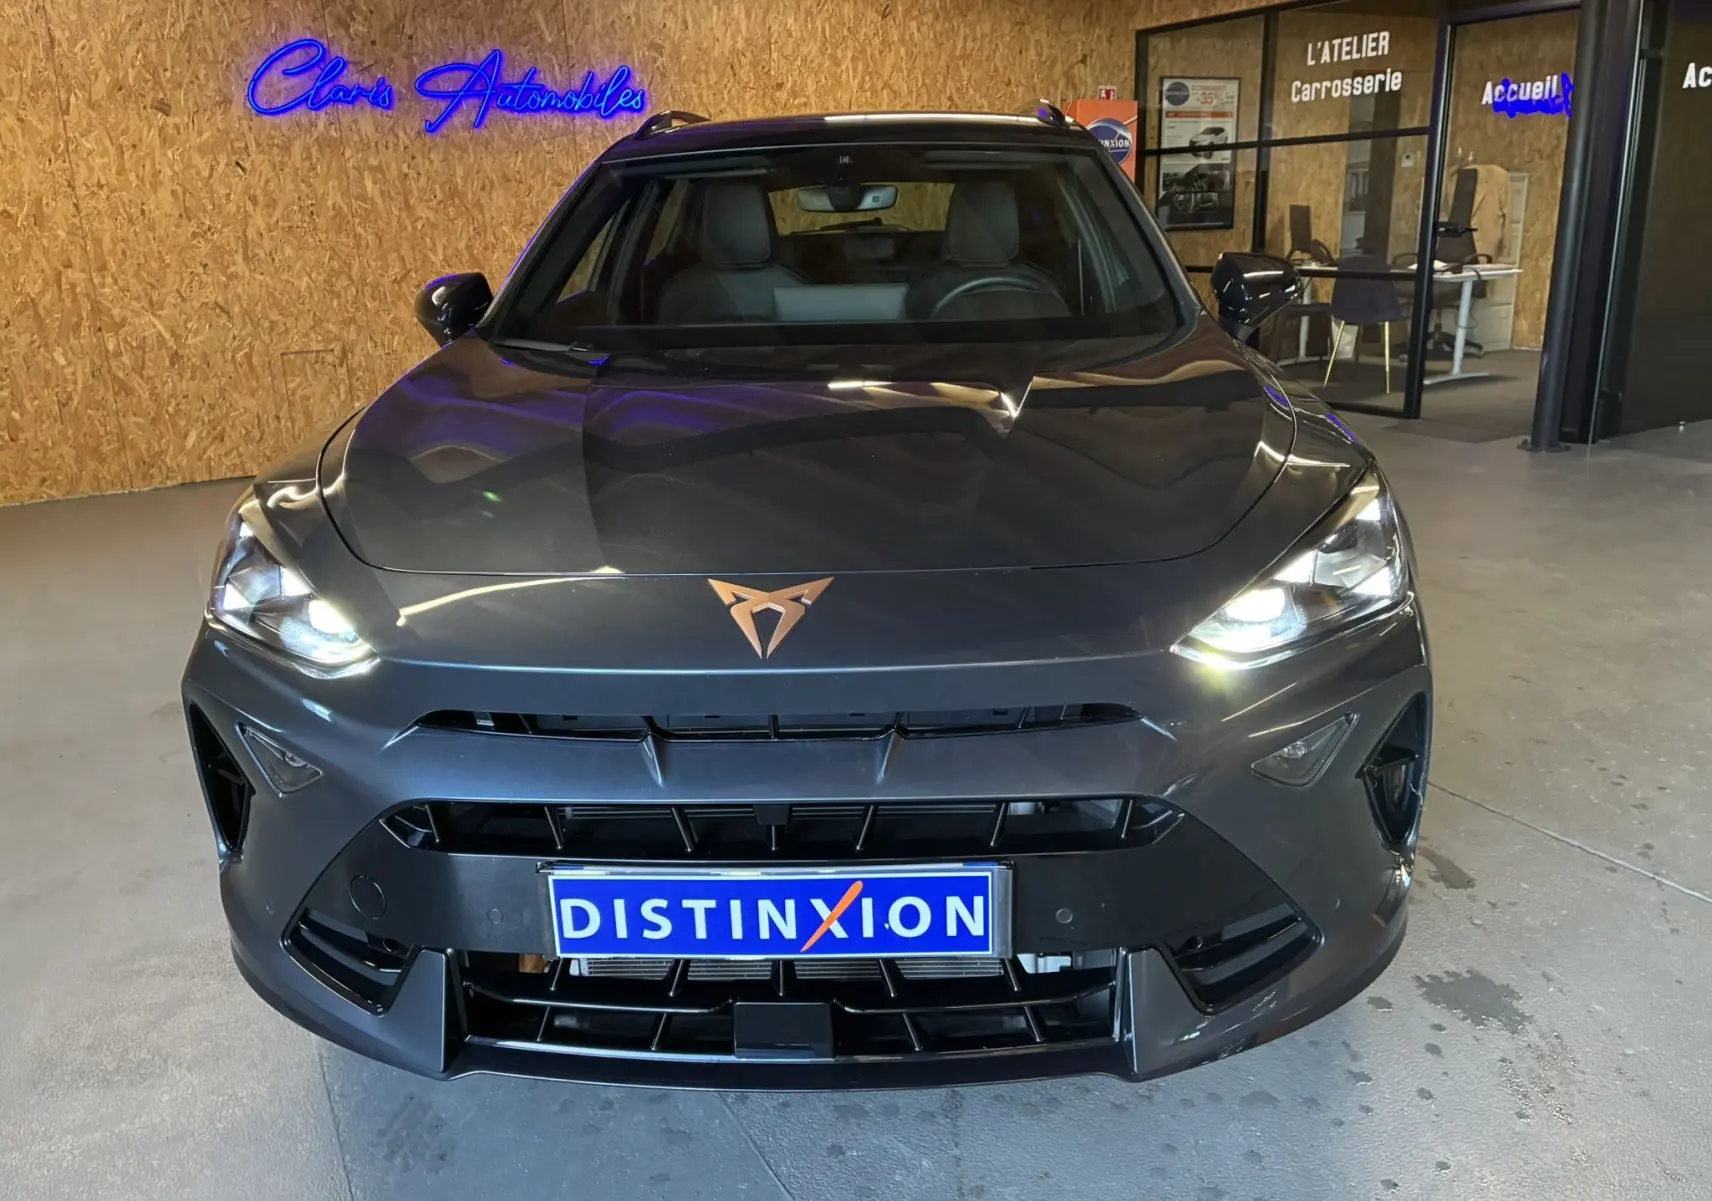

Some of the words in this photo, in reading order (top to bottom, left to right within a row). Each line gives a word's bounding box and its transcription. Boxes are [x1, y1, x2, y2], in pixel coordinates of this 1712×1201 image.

[1307, 31, 1390, 66] L'ATELIER
[248, 38, 393, 116] Claris
[414, 49, 646, 134] Automobiles
[1291, 68, 1403, 103] Carrosserie
[1481, 75, 1559, 105] Accueil
[559, 881, 985, 951] DISTINXION
